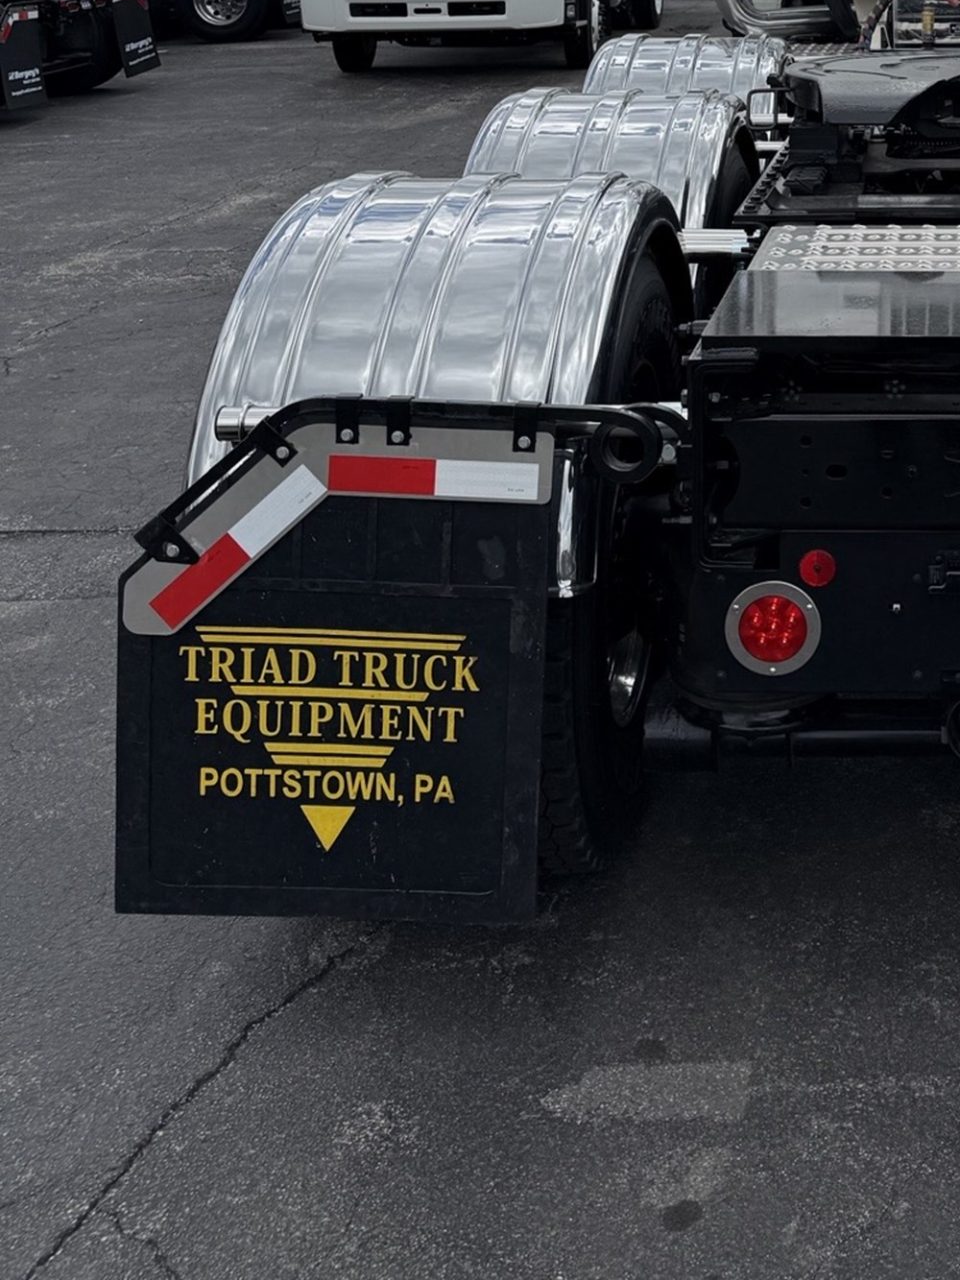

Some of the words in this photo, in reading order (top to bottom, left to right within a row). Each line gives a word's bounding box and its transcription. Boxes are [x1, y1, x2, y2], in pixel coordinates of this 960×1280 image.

[179, 645, 317, 685] TRIAD
[333, 650, 480, 692] TRUCK
[194, 698, 465, 744] EQUIPMENT
[198, 766, 405, 807] POTTSTOWN,
[414, 773, 455, 804] PA
